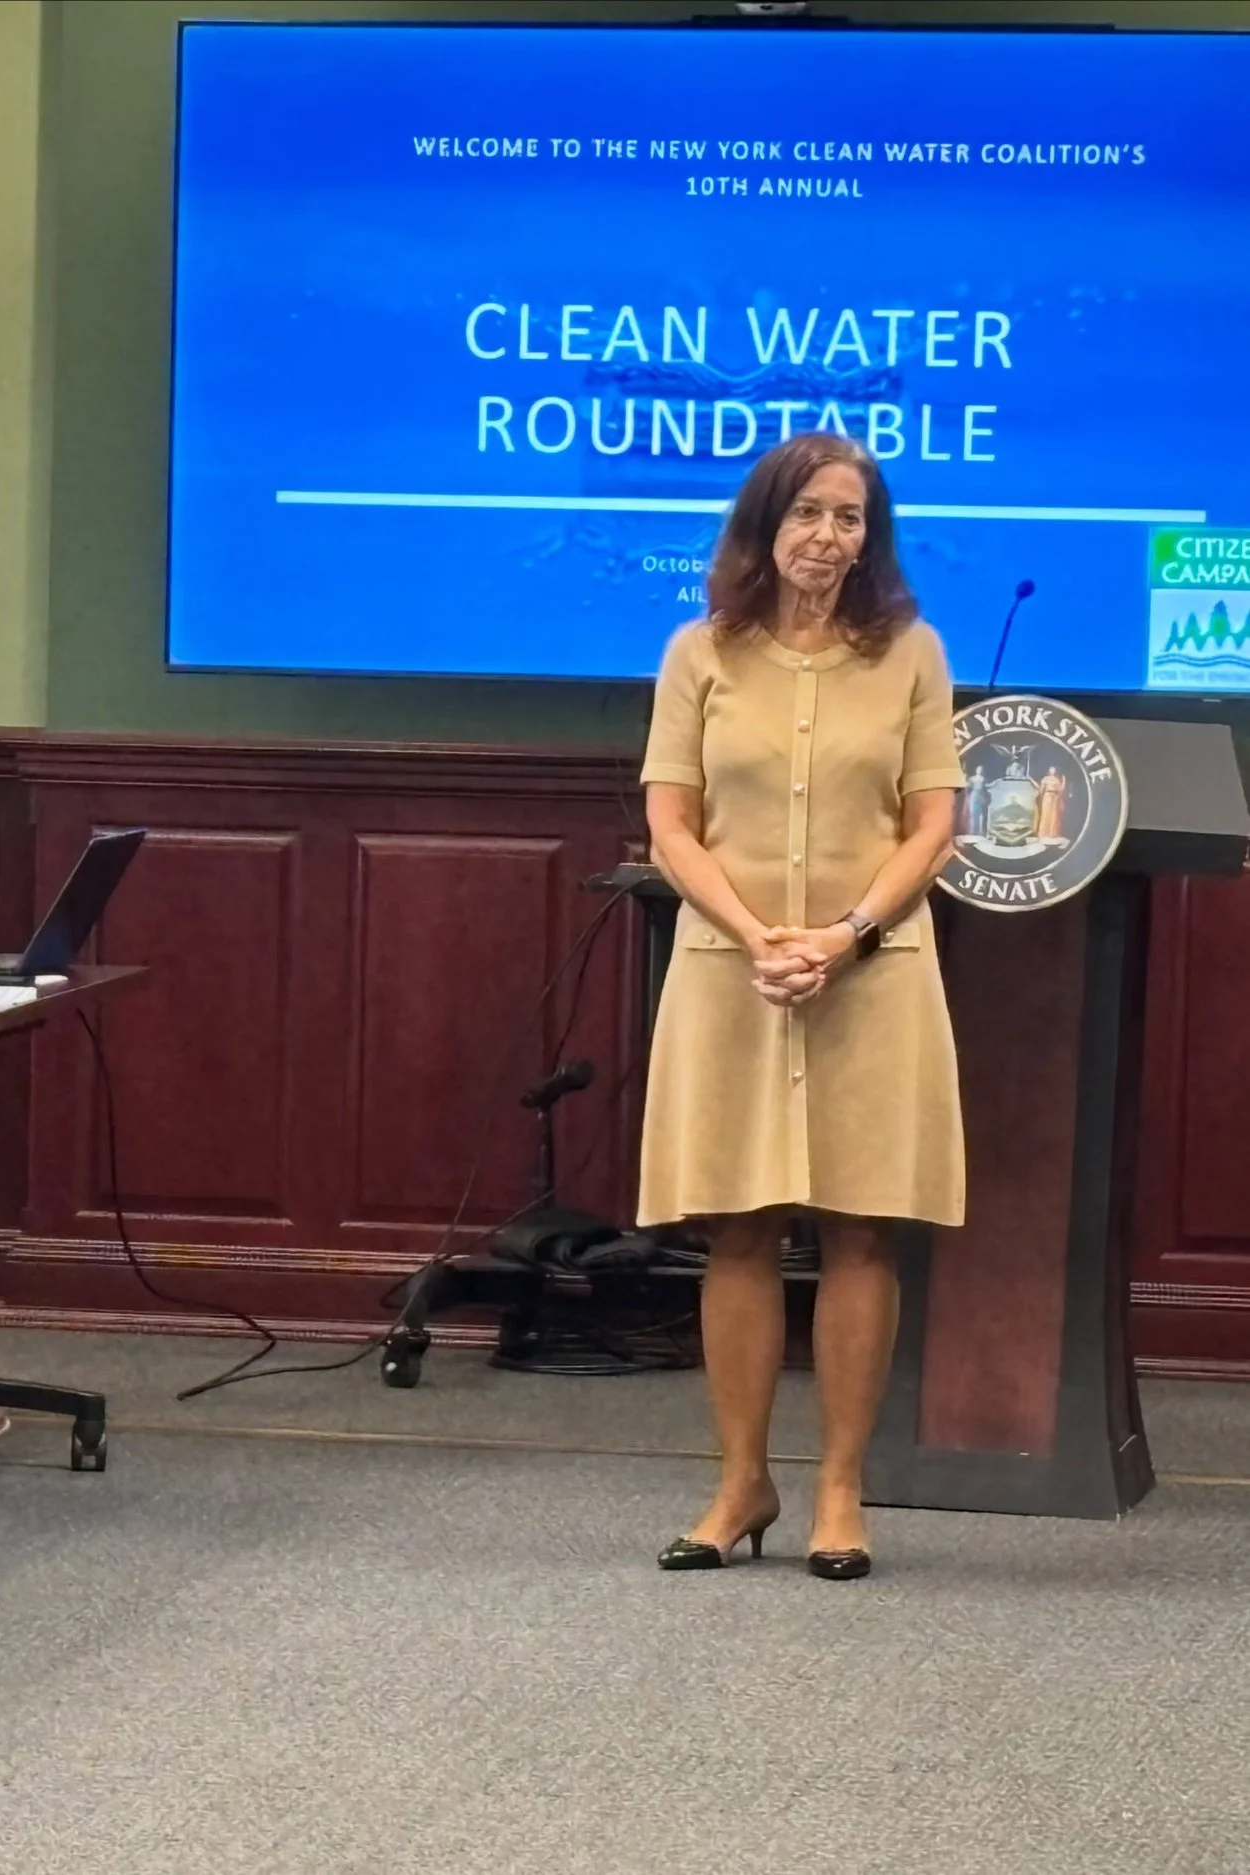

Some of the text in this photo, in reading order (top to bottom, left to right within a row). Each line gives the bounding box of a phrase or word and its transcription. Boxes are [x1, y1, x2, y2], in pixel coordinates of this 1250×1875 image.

[413, 137, 1145, 165] WELCOME TO THE NEW YORK CLEAN WATER COALITION'S
[686, 176, 863, 198] 10TH ANNUAL
[465, 302, 1012, 369] CLEAN WATER
[642, 554, 708, 573] Octob
[973, 705, 1113, 784] YORK STATE
[958, 869, 1059, 901] SENATE
